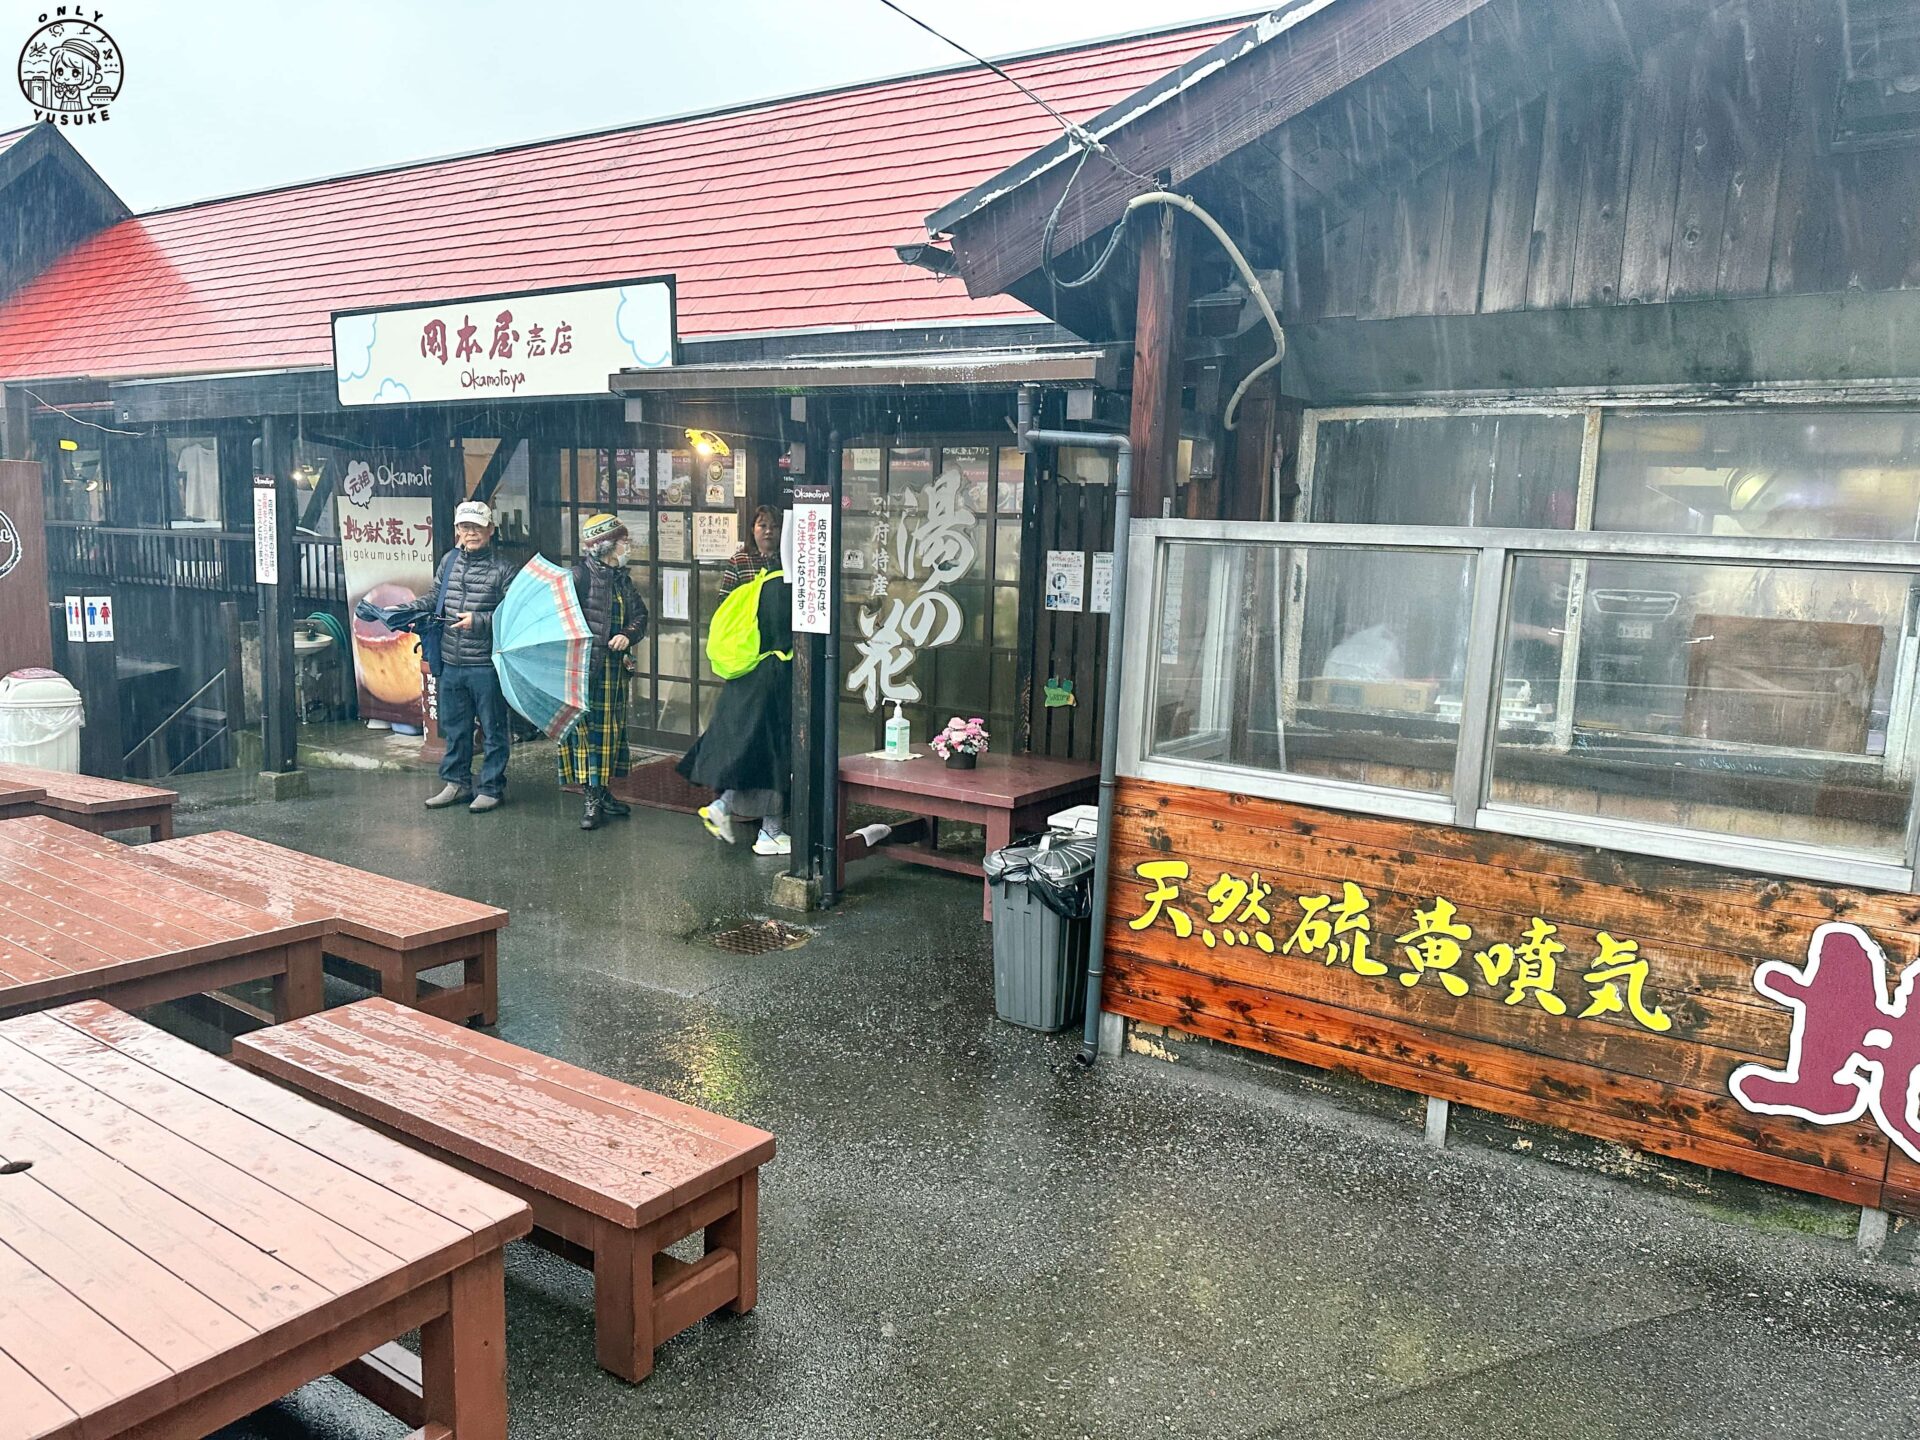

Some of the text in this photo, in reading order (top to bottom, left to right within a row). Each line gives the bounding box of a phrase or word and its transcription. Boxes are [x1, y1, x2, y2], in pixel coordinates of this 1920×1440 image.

[460, 369, 526, 393] Okamotoya
[349, 470, 371, 497] 元祖
[698, 515, 730, 528] 営業時間
[794, 488, 830, 502] Okamotoya
[797, 518, 807, 616] ご注文となります。
[807, 510, 817, 625] お席をとられてからの
[817, 518, 827, 617] 店内ご利用の方は、
[870, 495, 891, 597] 別府特産
[1128, 860, 1672, 1032] 天然硫黄噴気
